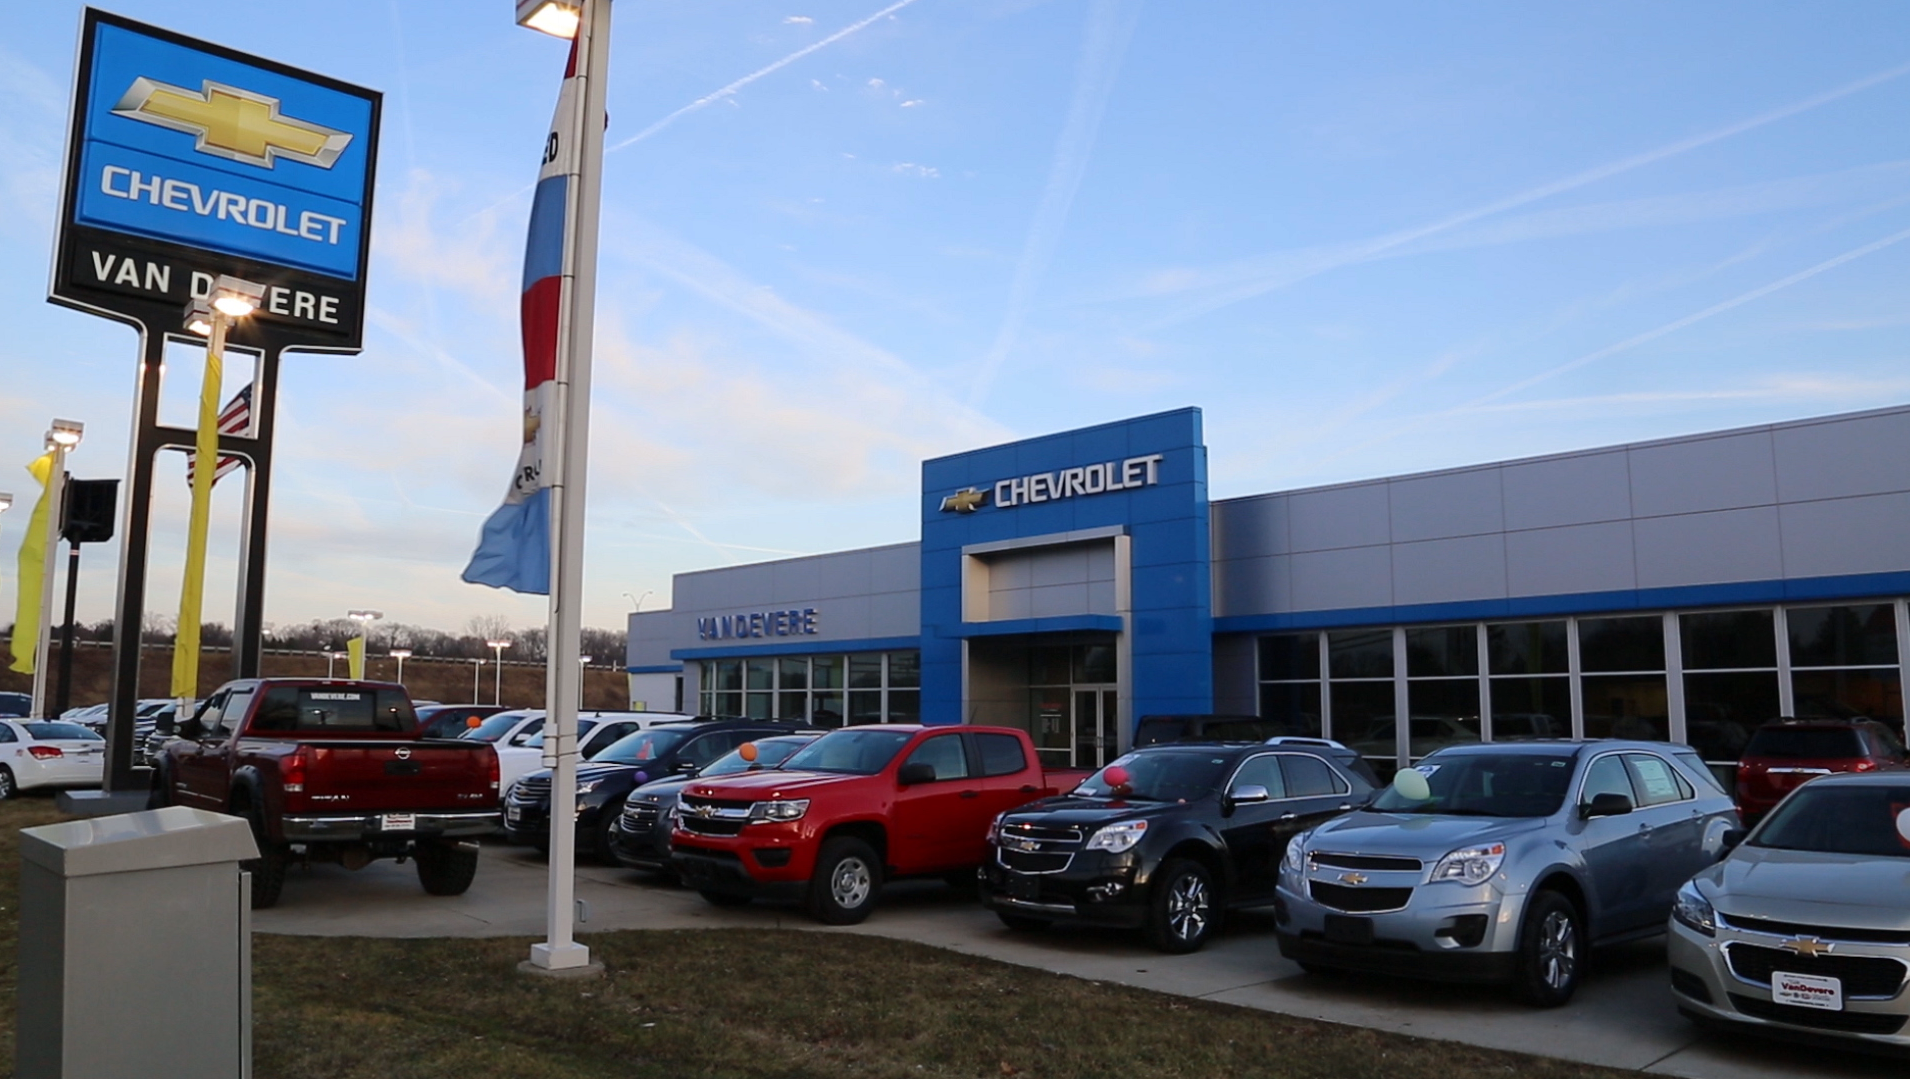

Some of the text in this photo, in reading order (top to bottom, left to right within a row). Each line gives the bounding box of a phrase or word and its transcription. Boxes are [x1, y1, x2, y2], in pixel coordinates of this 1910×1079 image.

[101, 165, 347, 245] CHEVROLET
[92, 251, 340, 325] VAN DERE
[995, 453, 1163, 508] CHEVROLET
[697, 608, 818, 640] VANDEVERE
